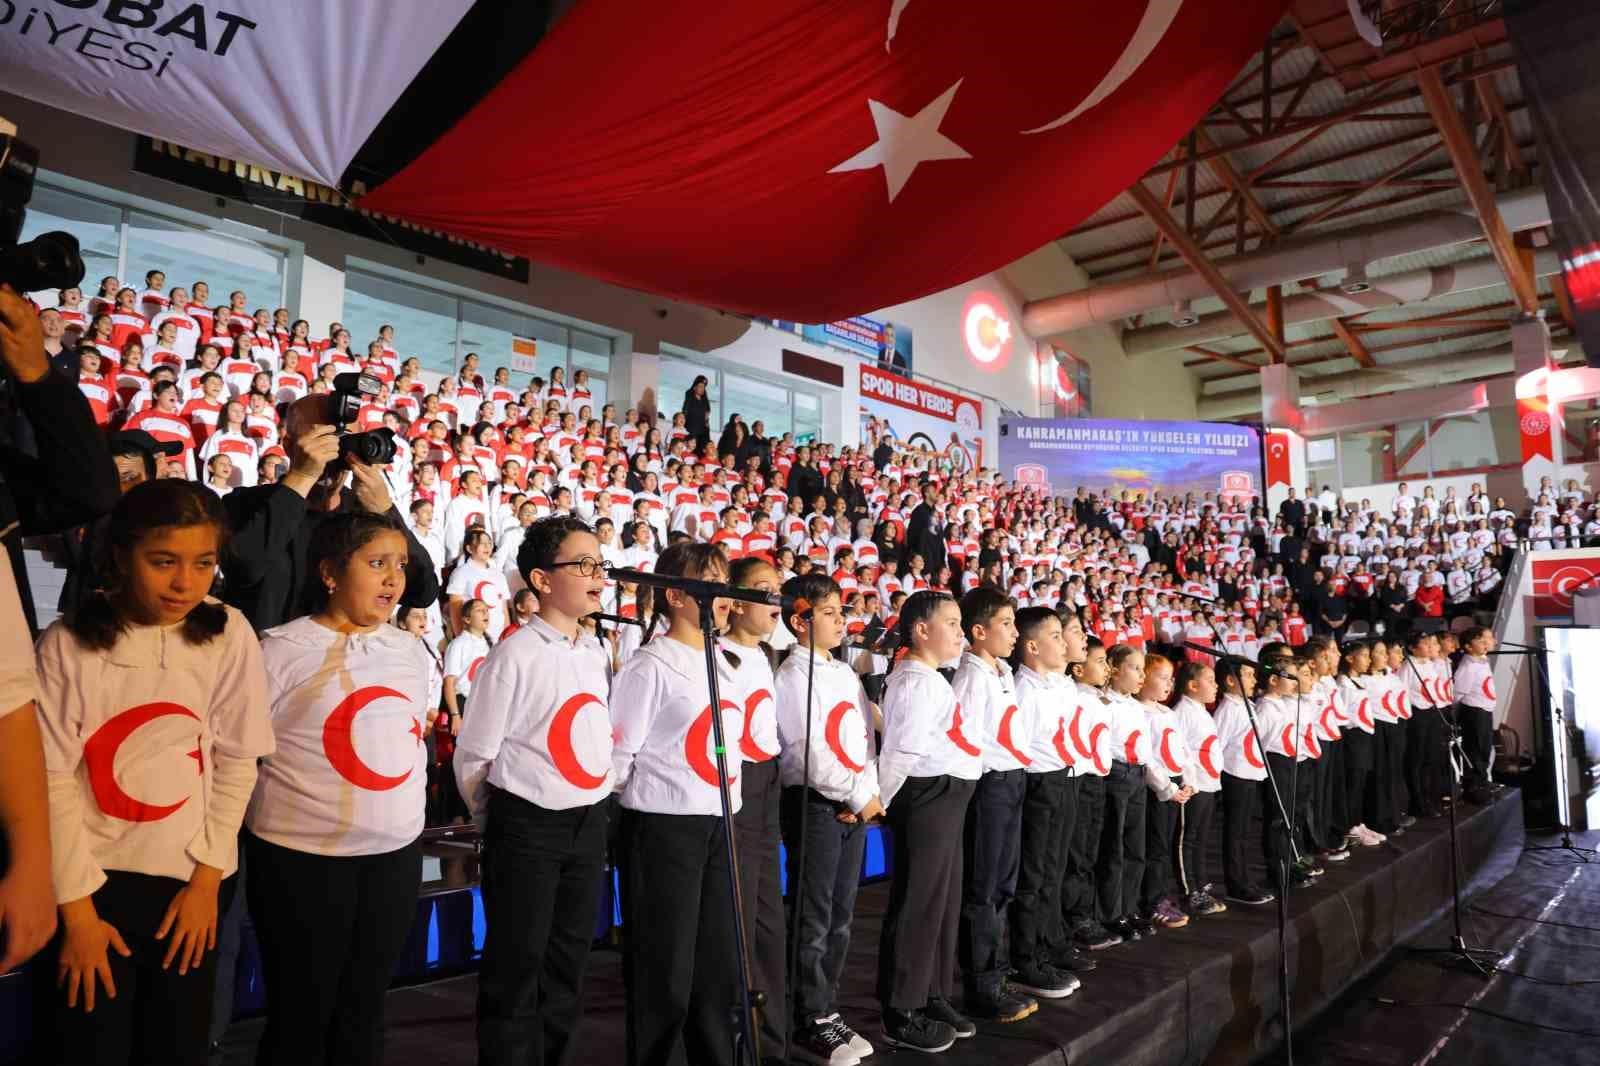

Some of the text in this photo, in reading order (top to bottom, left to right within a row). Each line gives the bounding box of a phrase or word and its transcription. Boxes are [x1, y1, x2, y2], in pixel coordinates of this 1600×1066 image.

[53, 0, 257, 56] BAT
[862, 372, 954, 416] SPOR HER YERDE
